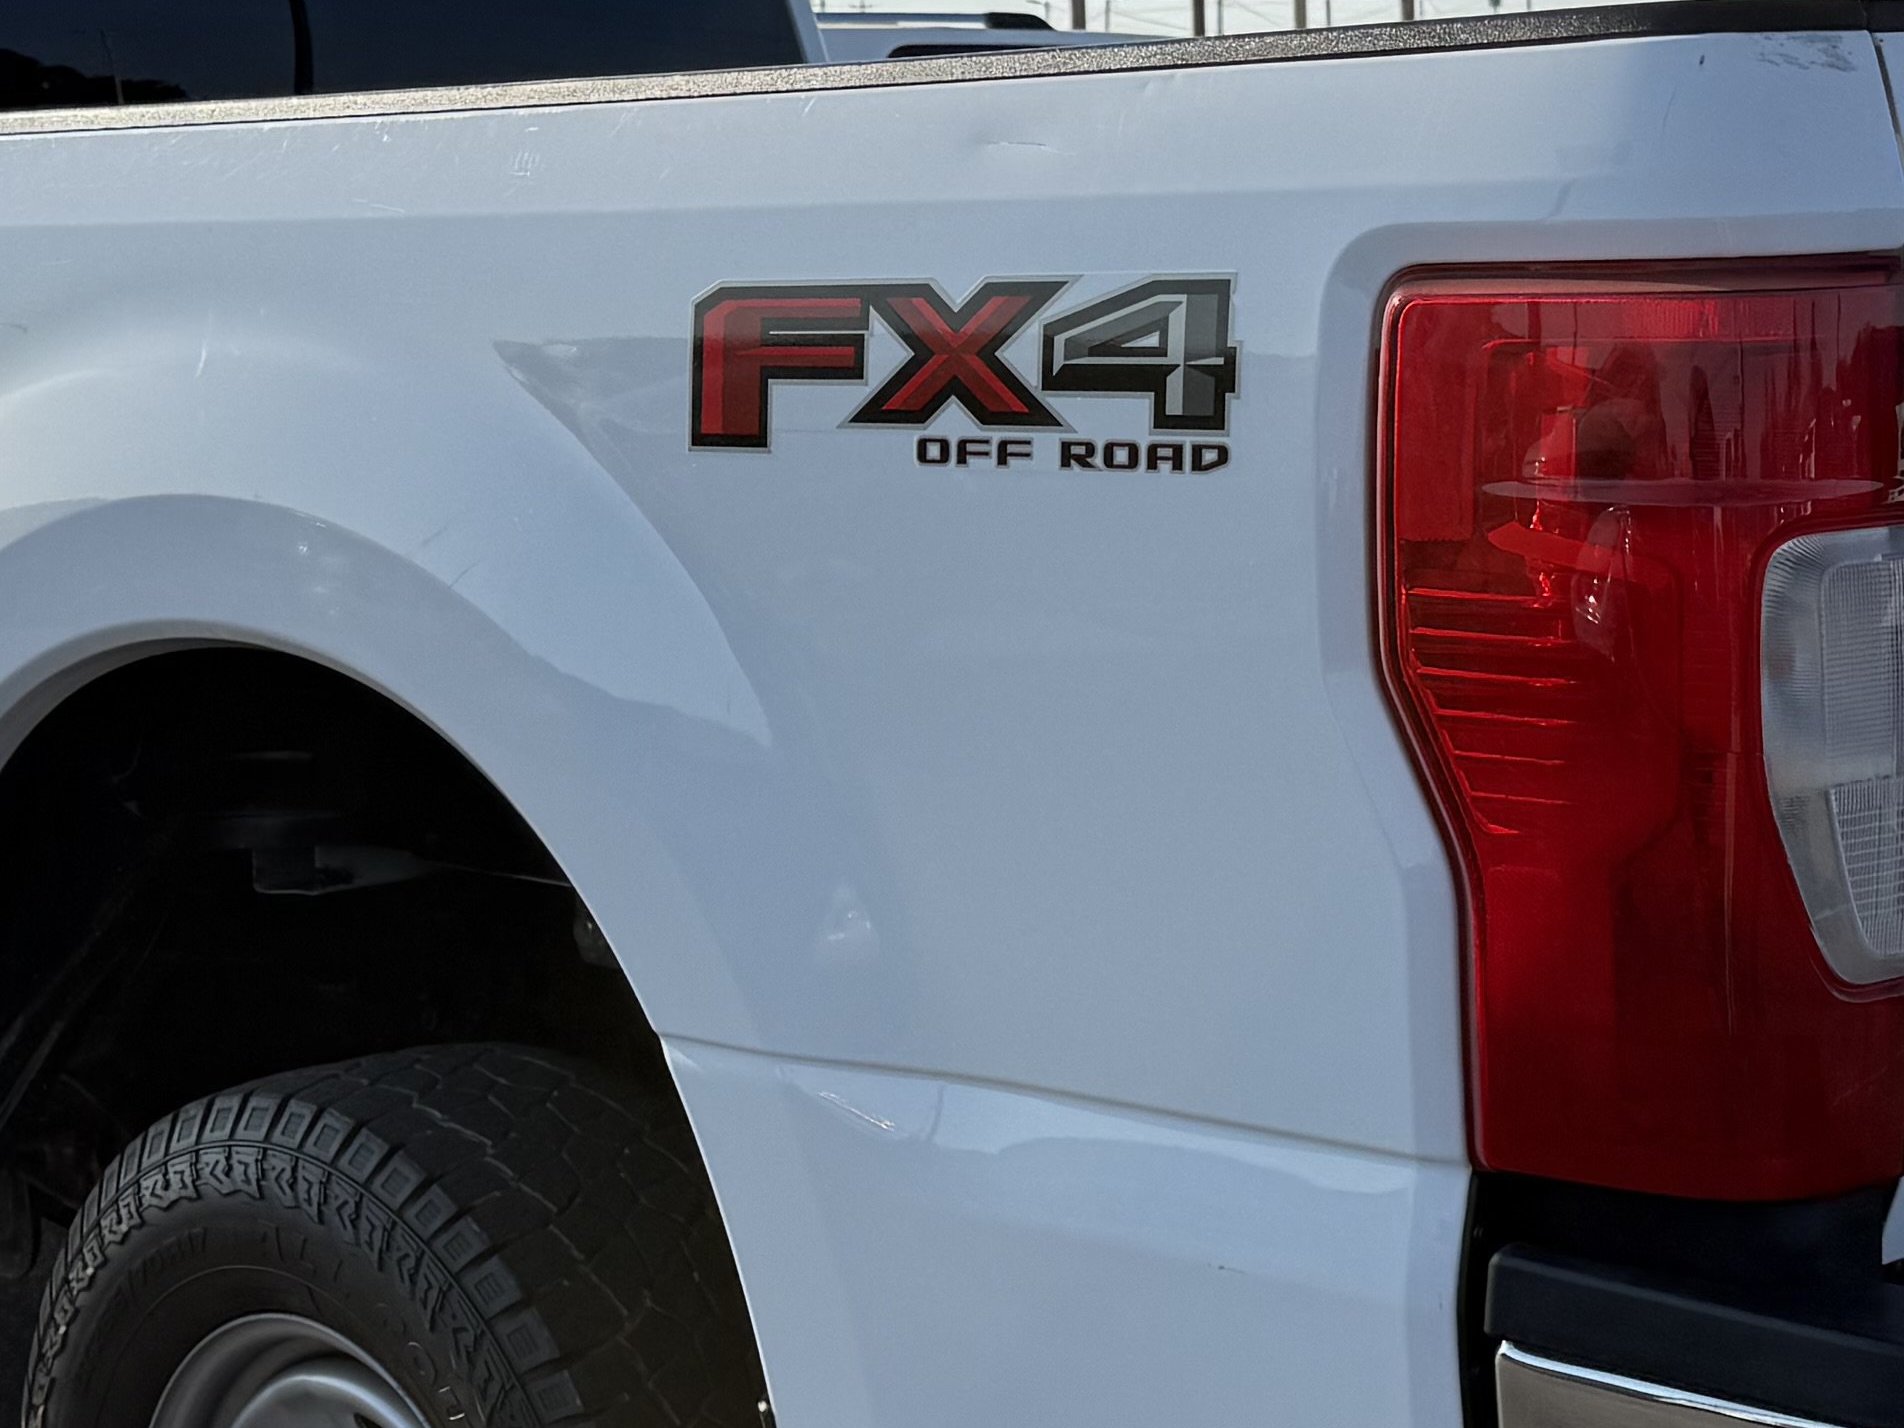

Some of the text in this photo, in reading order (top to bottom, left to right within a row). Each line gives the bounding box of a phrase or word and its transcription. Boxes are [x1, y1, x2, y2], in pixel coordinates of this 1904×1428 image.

[688, 272, 1240, 453] FX4
[915, 436, 1231, 474] OFF ROAD
